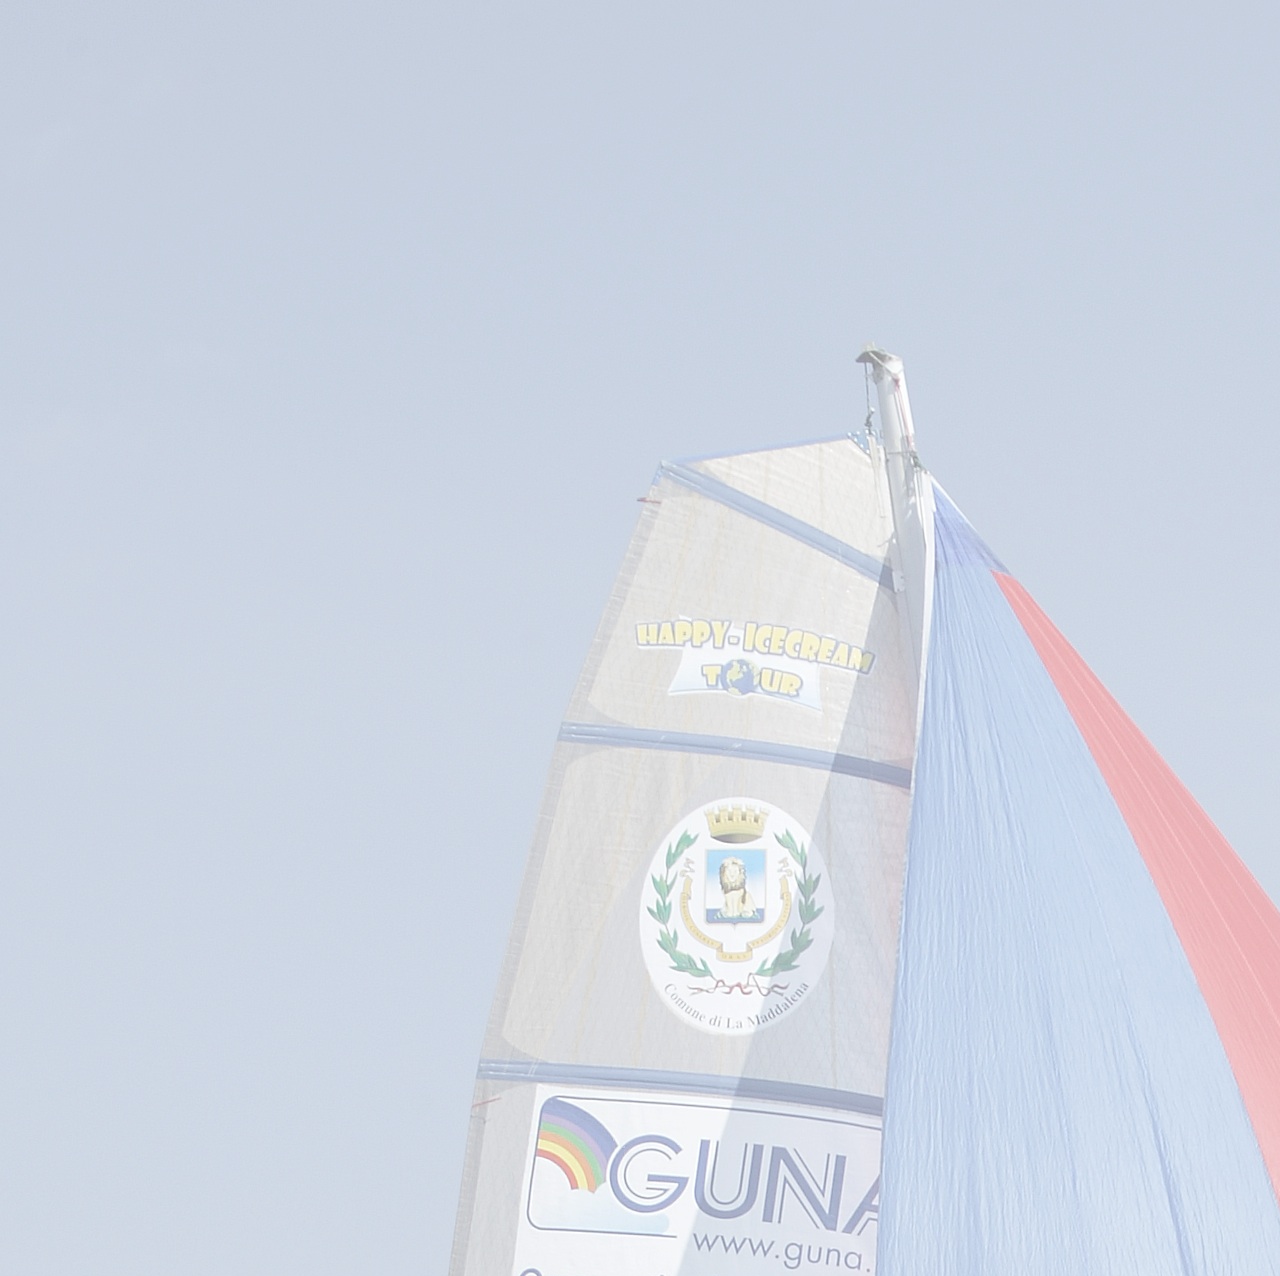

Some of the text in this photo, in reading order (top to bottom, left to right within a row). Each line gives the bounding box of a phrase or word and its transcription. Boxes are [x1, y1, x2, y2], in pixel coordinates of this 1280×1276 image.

[664, 982, 809, 1029] Comune di La Maddalena
